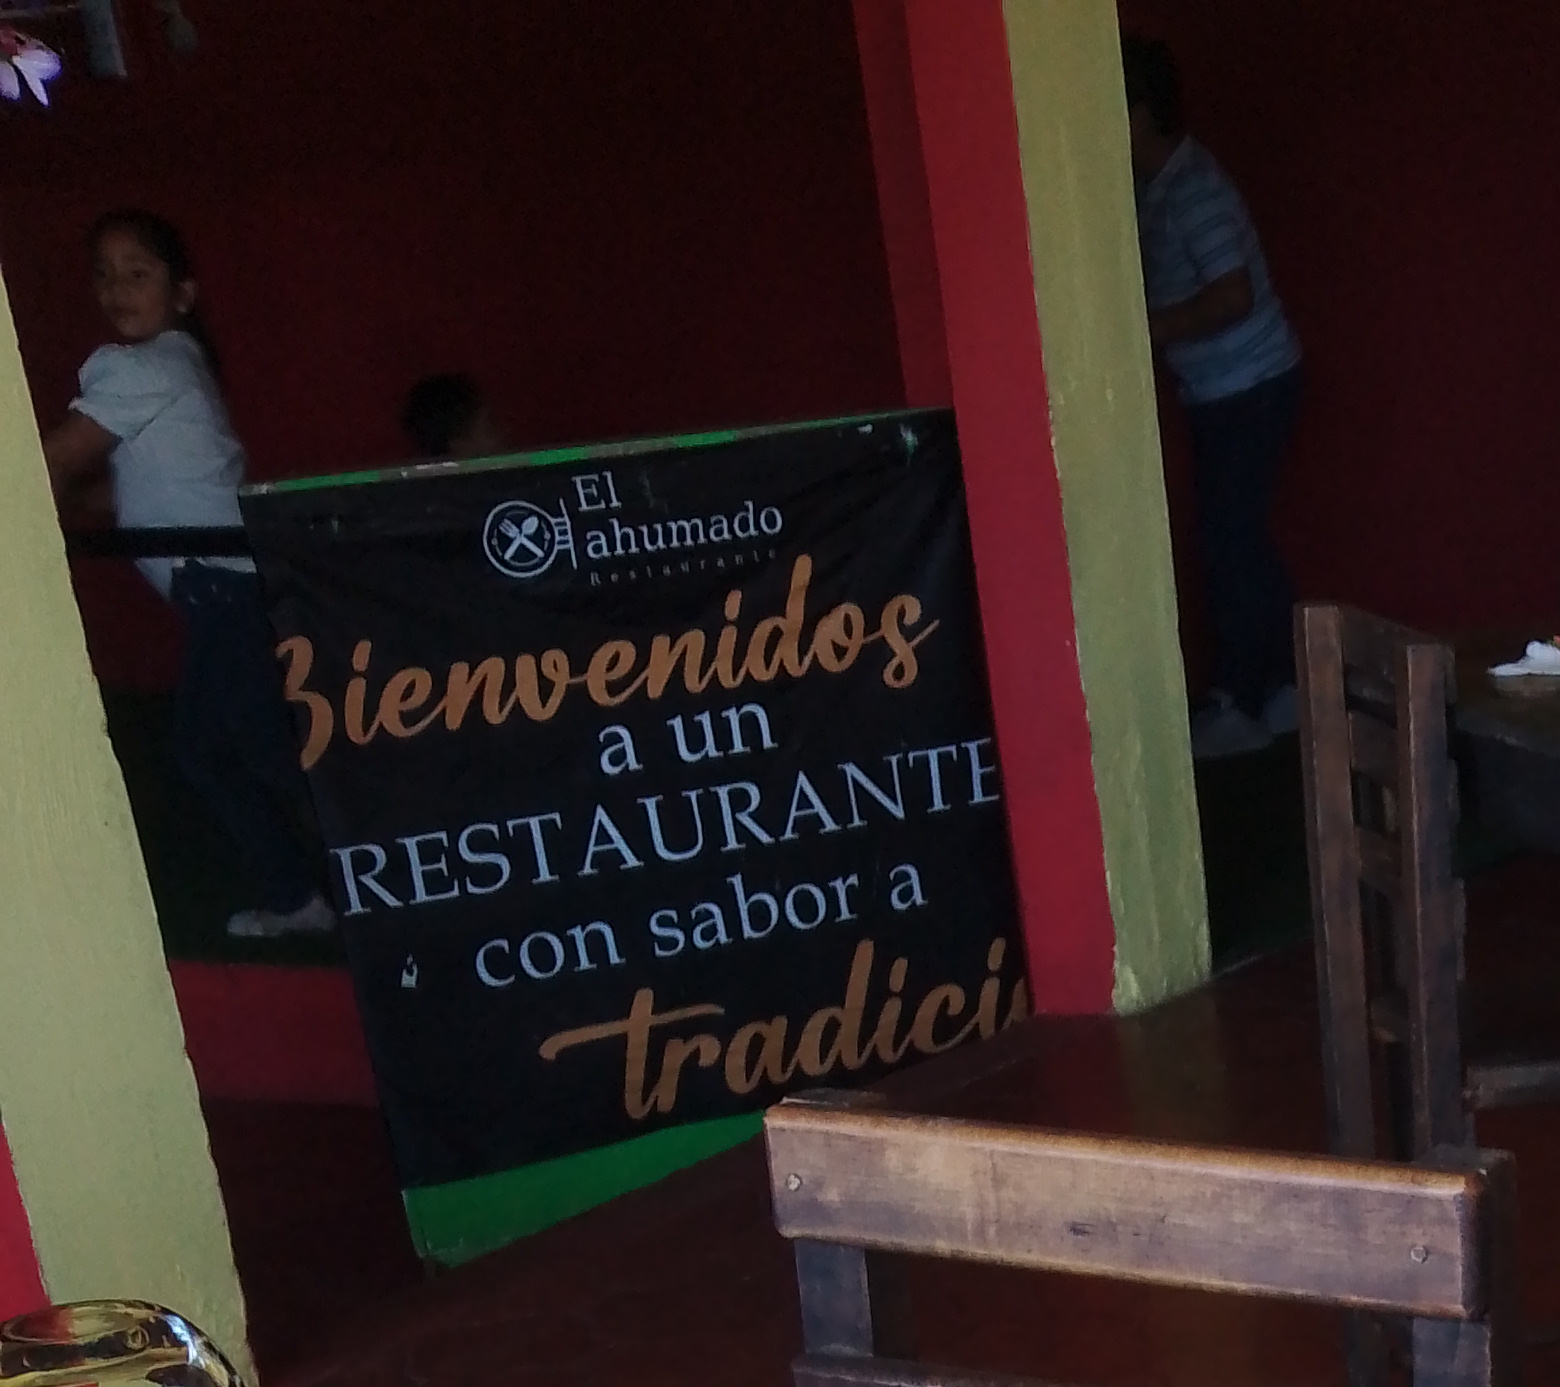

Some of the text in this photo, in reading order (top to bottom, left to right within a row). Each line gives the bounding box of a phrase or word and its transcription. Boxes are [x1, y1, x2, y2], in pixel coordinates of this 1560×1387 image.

[571, 470, 622, 512] El
[586, 500, 783, 560] ahumado
[599, 702, 778, 776] a un
[330, 737, 1000, 917] RESTAURANTE
[475, 862, 928, 988] con sabor a
